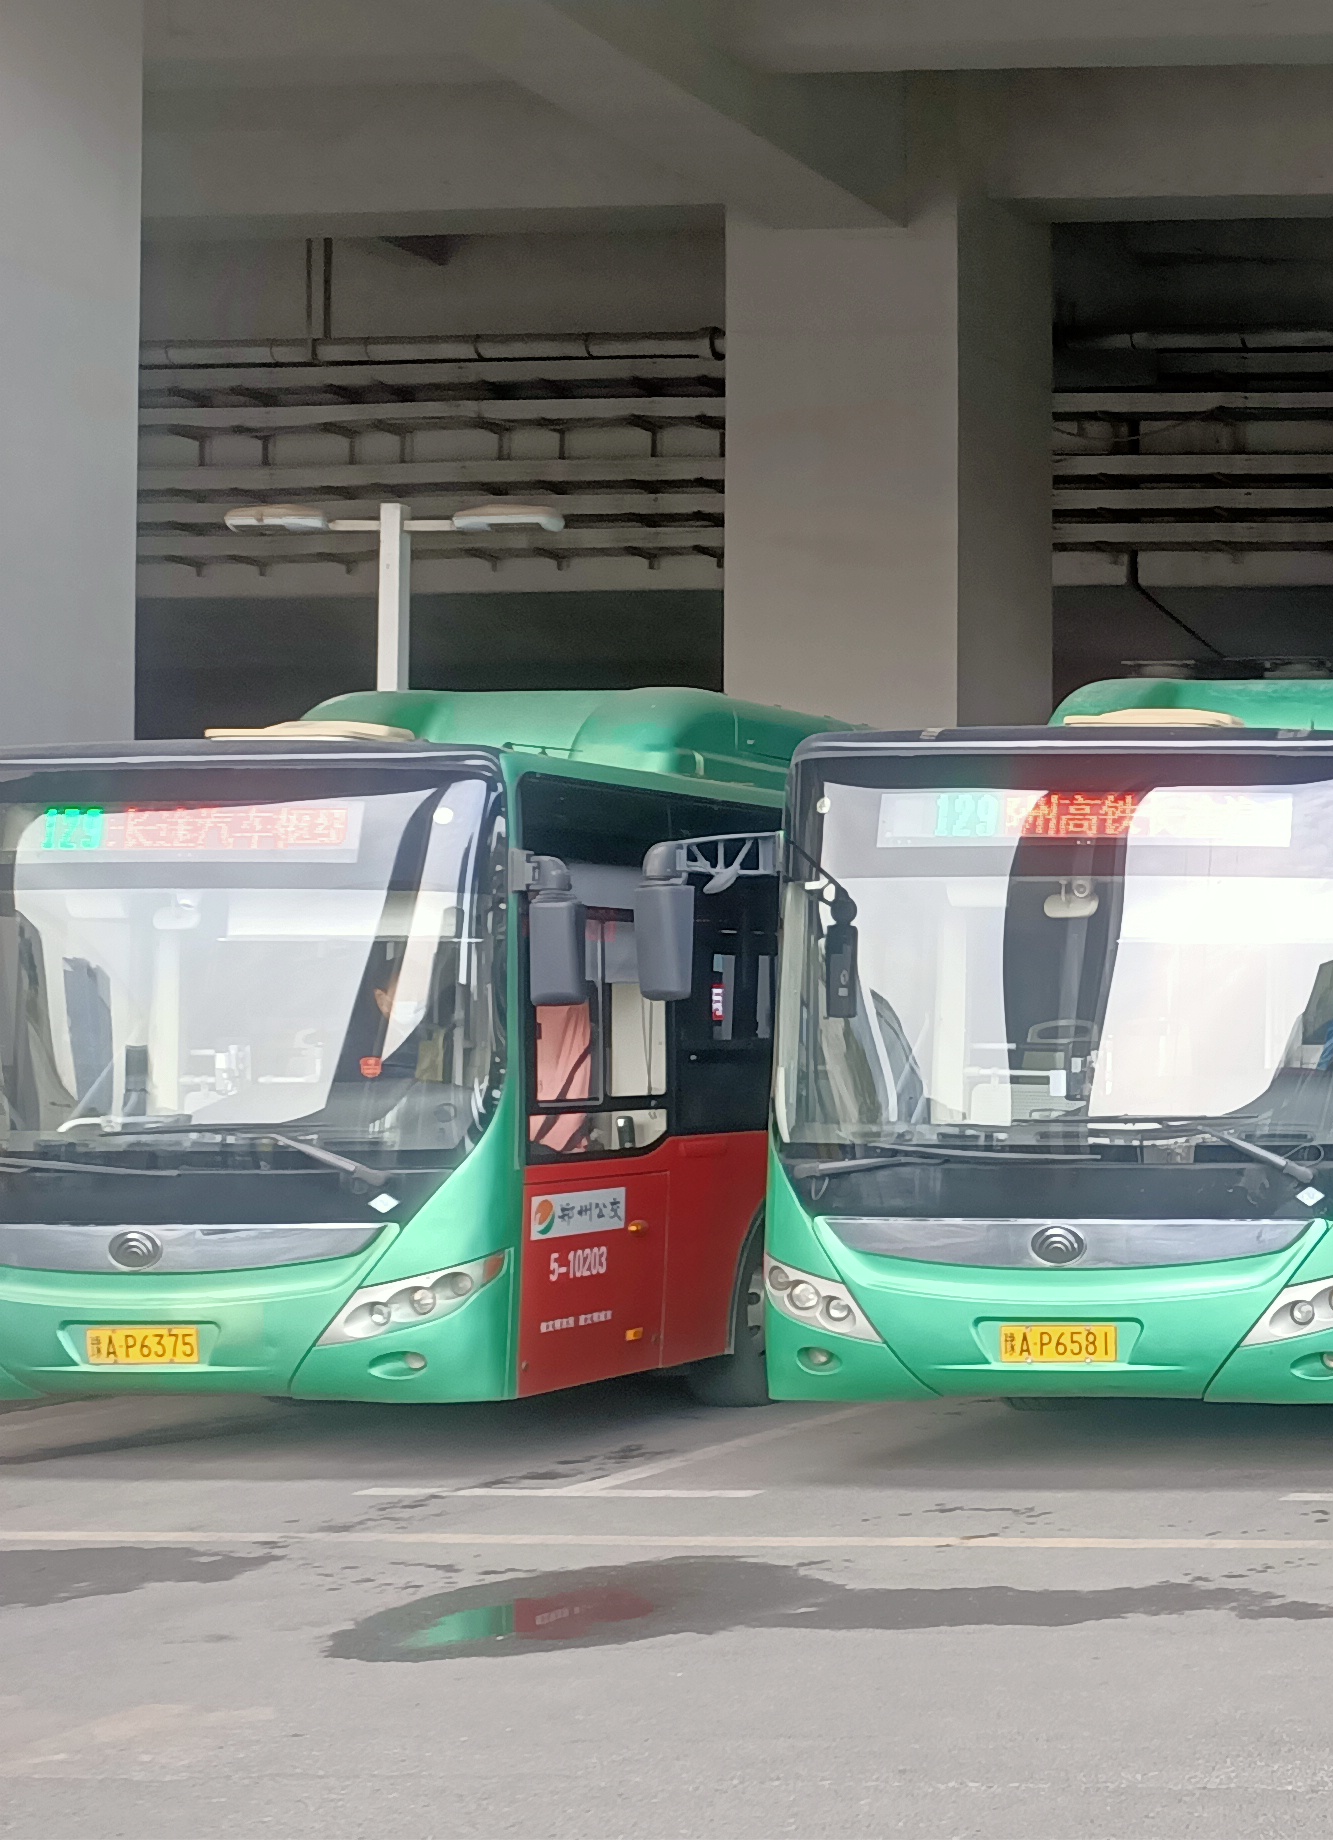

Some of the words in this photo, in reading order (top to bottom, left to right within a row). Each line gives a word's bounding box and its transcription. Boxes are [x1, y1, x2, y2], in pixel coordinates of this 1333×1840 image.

[41, 808, 104, 850] 129
[935, 794, 1000, 837] 129
[549, 1245, 608, 1282] 5-10203
